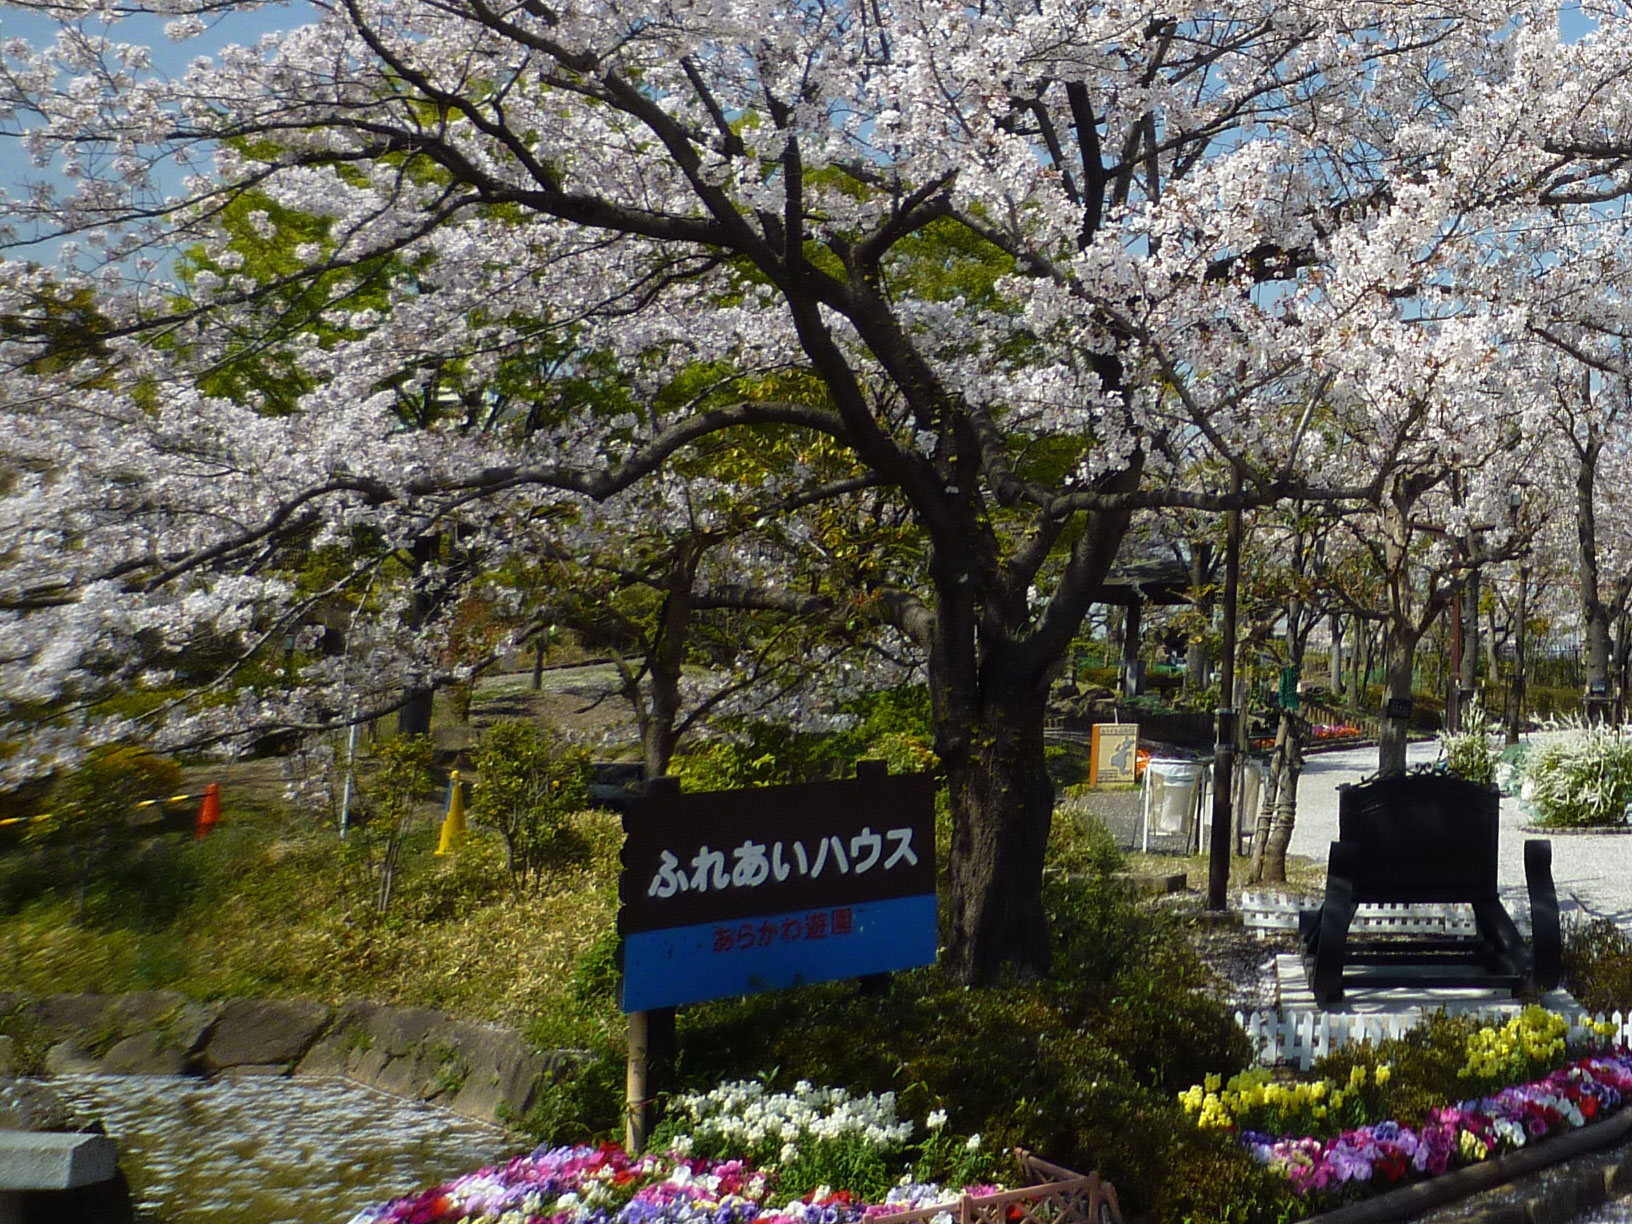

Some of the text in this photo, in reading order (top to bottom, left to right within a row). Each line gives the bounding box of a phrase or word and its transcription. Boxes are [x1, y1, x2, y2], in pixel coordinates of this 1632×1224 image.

[648, 827, 918, 898] ふれあいハウス
[713, 908, 853, 952] あらかわ遊園
